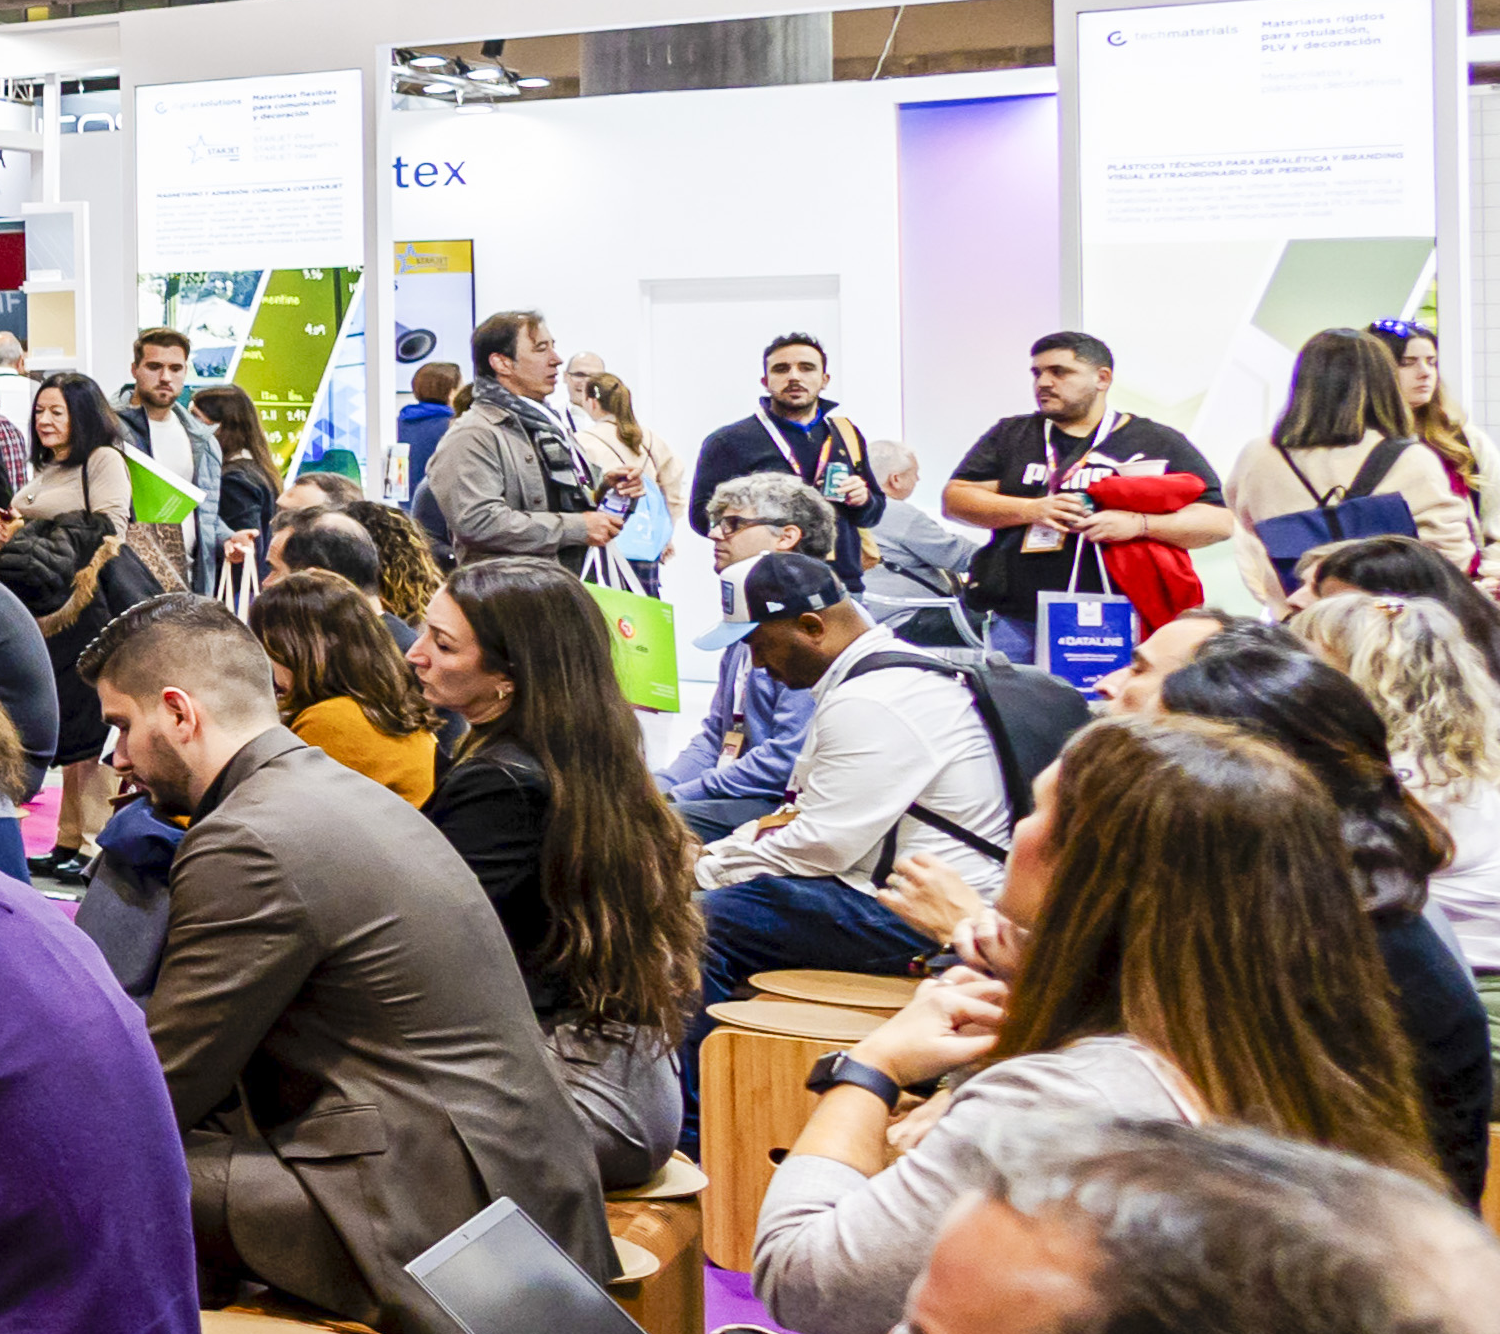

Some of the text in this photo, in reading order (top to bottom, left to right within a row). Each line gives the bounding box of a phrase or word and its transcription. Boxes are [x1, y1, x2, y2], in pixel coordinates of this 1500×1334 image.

[1260, 12, 1385, 29] Materiales rígidos
[1134, 23, 1239, 41] techmaterials
[1260, 32, 1291, 43] para
[1260, 35, 1383, 52] PLV y decoración
[252, 92, 297, 102] Materiales
[274, 99, 336, 109] comunicación
[260, 110, 309, 120] decoración
[1107, 162, 1166, 172] PLÁSTICOS
[1169, 160, 1223, 170] TÉCNICOS
[1225, 158, 1255, 168] PARA
[1258, 153, 1328, 166] SEÑALÉTICA
[1341, 151, 1405, 162] BRANDING
[1107, 164, 1332, 181] VISUAL EXTRAORDINARIO QUE PERDURA
